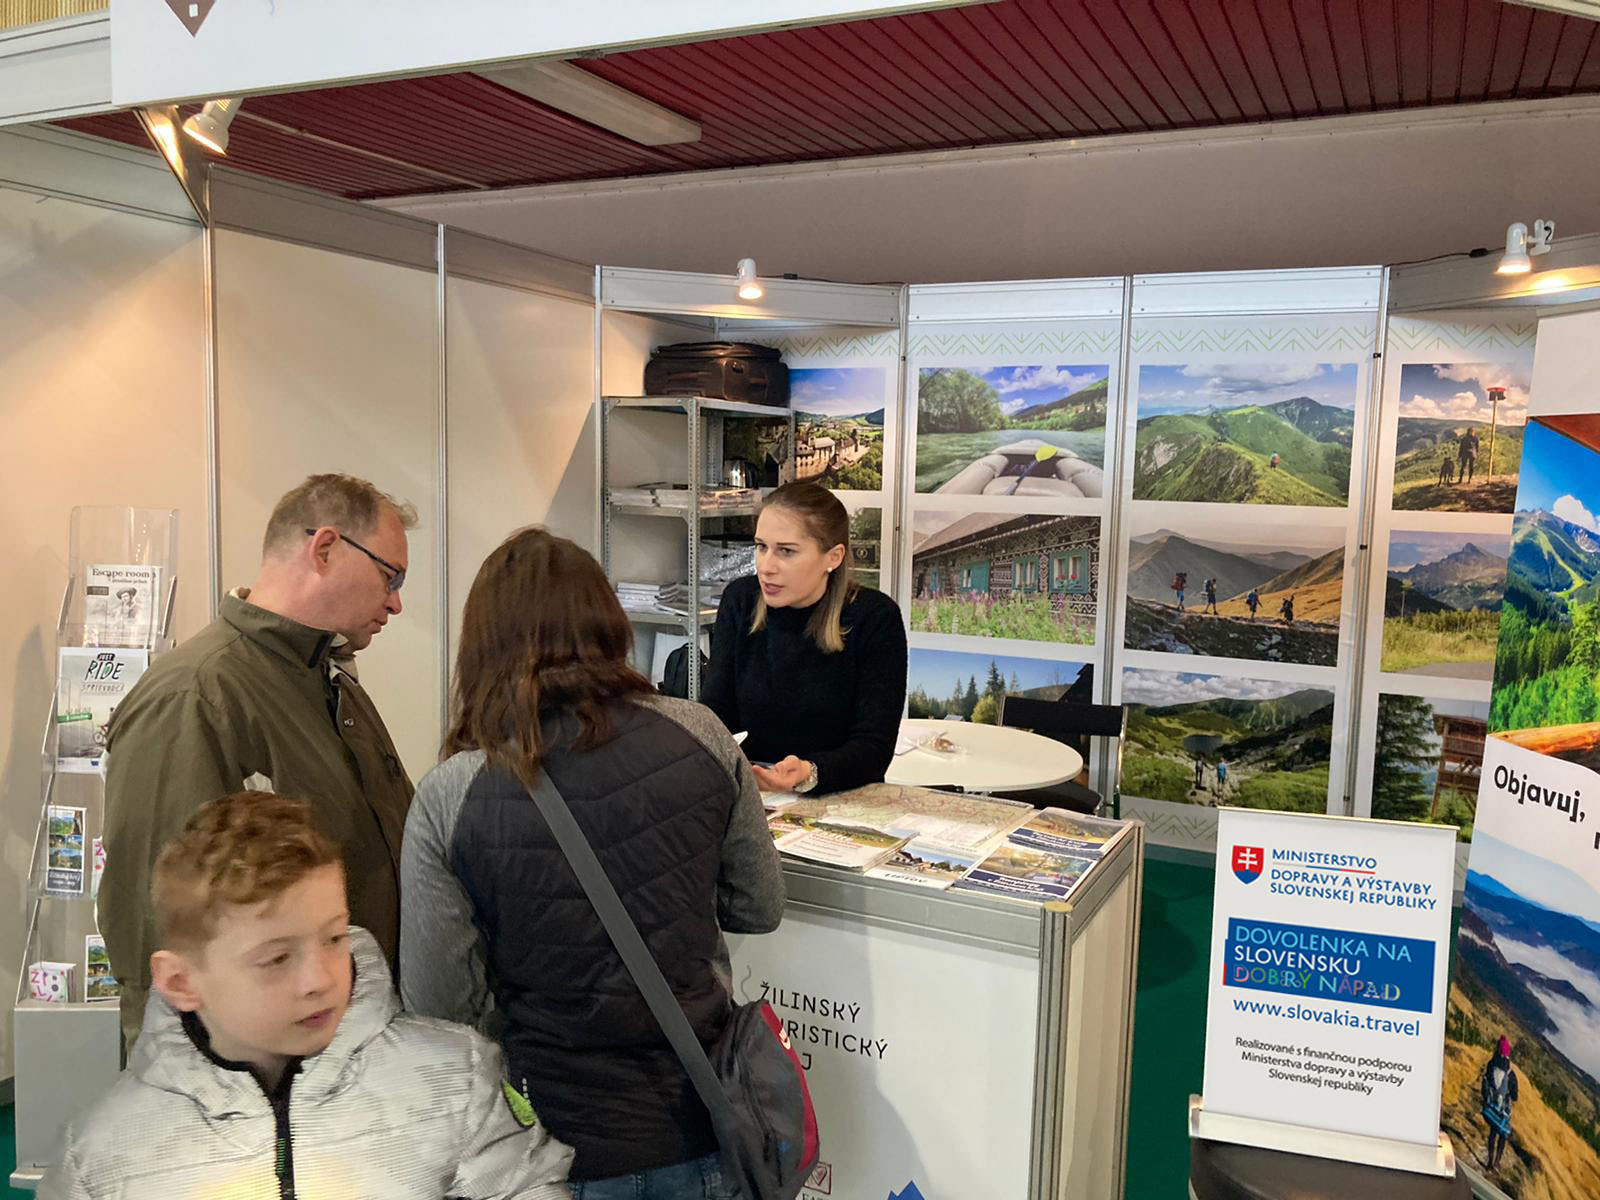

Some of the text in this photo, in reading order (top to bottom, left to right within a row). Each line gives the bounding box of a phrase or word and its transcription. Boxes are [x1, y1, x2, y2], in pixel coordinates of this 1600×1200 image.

[92, 568, 150, 580] Escape room
[85, 660, 124, 680] RIDE
[1494, 765, 1585, 823] Objavuj,
[1272, 848, 1377, 869] MINISTERSTVO
[1270, 882, 1437, 910] SLOVENSKEJ REPUBLIKY
[1271, 869, 1432, 896] DOPRAVY A VÝSTAVBY
[1234, 945, 1361, 976] SLOVENSKU
[1235, 925, 1412, 963] DOVOLENKA NA
[1232, 966, 1401, 1001] DOBRÝ NÁPAD
[760, 981, 861, 1023] ŽILINSKÝ
[1233, 999, 1420, 1036] www.slovakia.travel
[1235, 1036, 1412, 1073] Realizované s finančnou podporou
[1241, 1051, 1404, 1087] Ministerstva dopravy a výstavby
[1268, 1068, 1374, 1096] Slovenskej republiky
